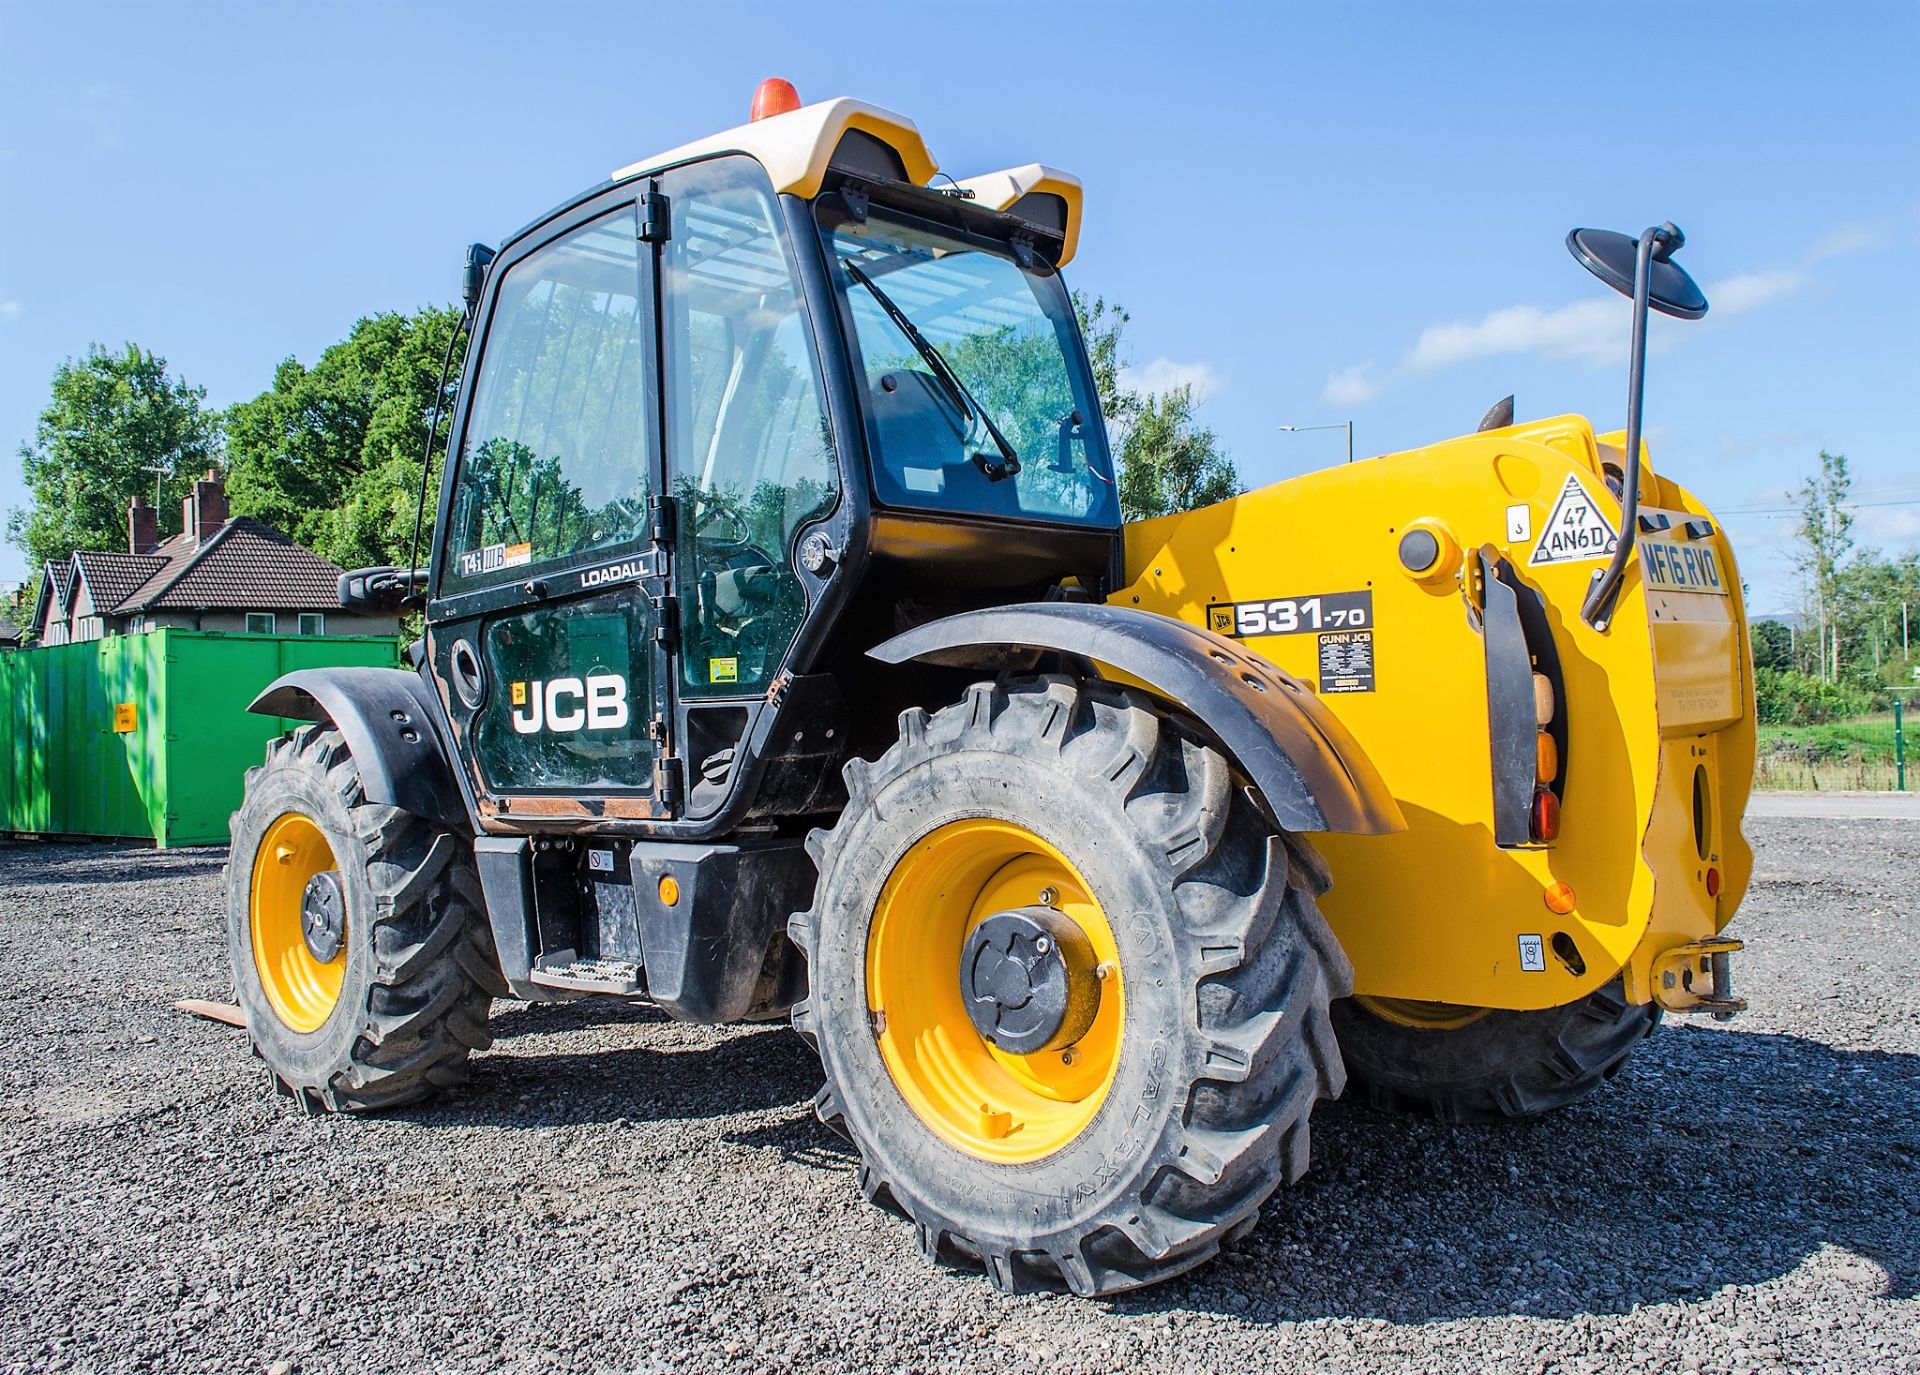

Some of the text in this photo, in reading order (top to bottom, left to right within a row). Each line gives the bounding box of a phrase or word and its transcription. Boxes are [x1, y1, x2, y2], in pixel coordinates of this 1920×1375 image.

[1563, 506, 1587, 528] 47
[1551, 526, 1604, 552] AN6D
[580, 560, 650, 588] LOADALL
[1641, 543, 1720, 587] MF16 RVO
[1213, 613, 1232, 630] JCB
[1236, 598, 1366, 635] 531-70
[1319, 632, 1372, 645] GUNN JCB
[512, 674, 629, 734] JCB
[1075, 1039, 1167, 1205] GALAXY
